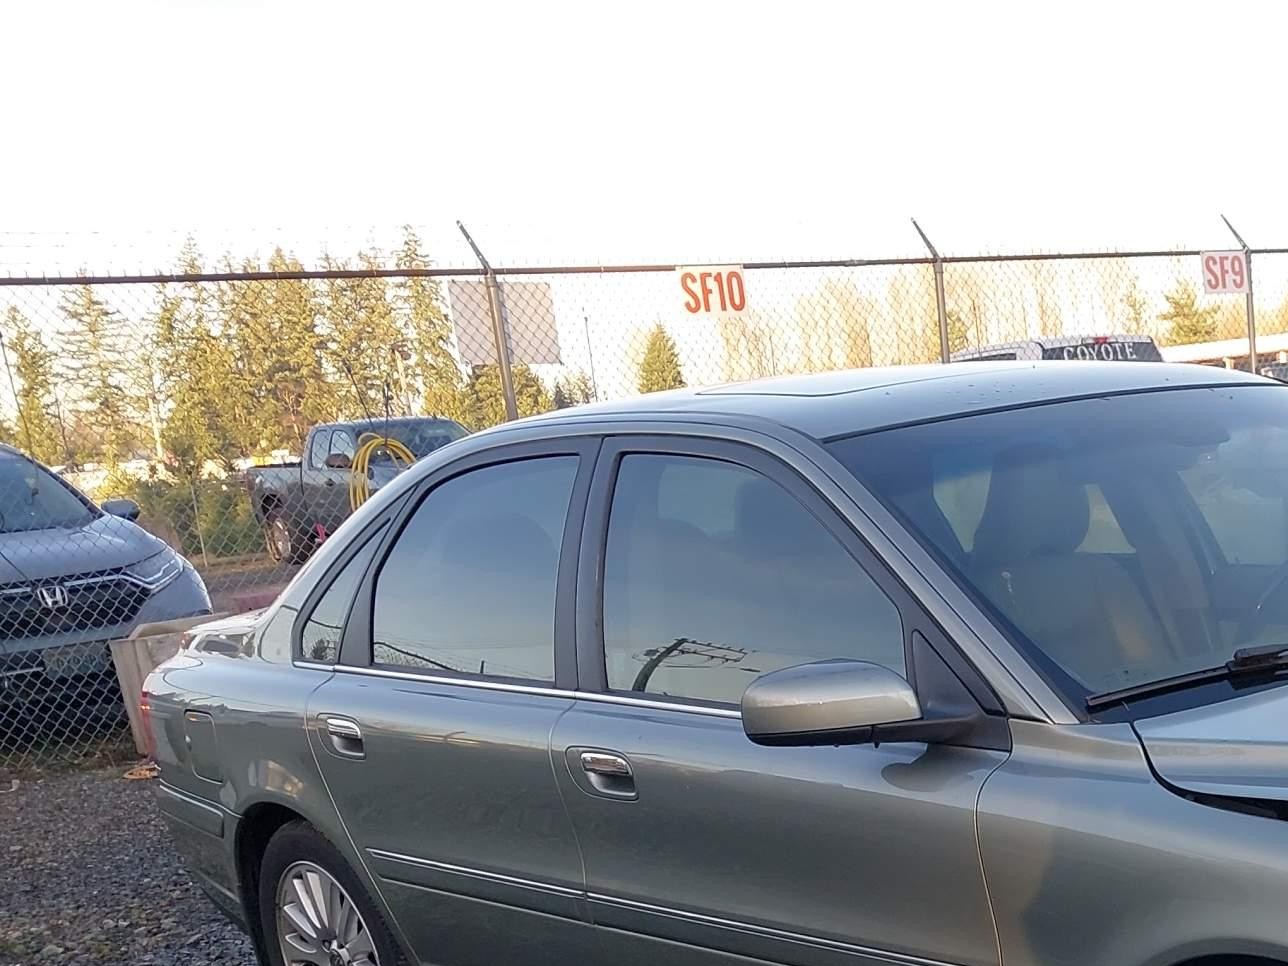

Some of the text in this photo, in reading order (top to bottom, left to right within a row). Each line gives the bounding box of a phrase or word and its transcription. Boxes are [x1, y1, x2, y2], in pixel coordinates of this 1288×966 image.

[1204, 255, 1245, 290] SF9
[681, 271, 746, 313] SF10
[1063, 342, 1137, 361] COYOTE
